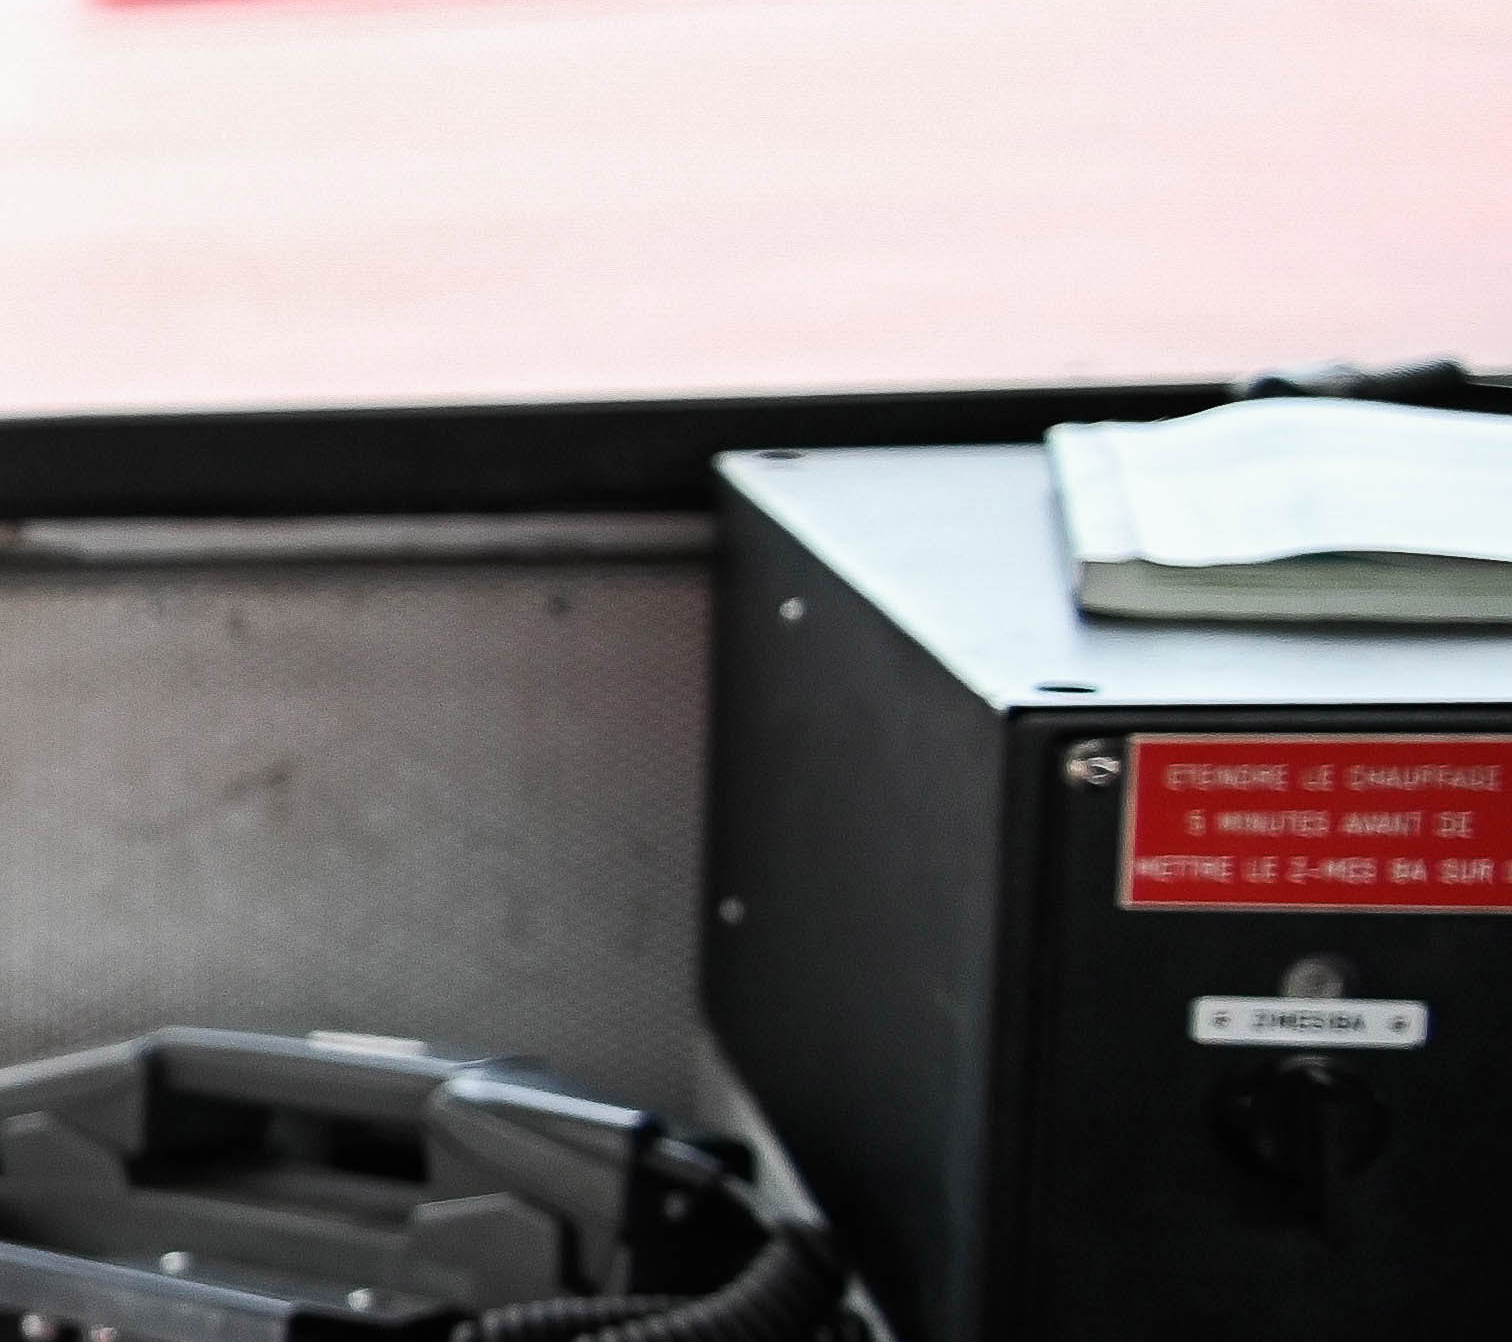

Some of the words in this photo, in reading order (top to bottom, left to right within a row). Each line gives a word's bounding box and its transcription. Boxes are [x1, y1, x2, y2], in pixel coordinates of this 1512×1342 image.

[1301, 764, 1334, 791] LE
[1215, 809, 1331, 837] MINUTES
[1339, 810, 1423, 837] AVANT
[1433, 810, 1474, 838] DE
[1135, 855, 1234, 883] METTRE
[1243, 855, 1279, 884] LE
[1437, 858, 1494, 884] SUR
